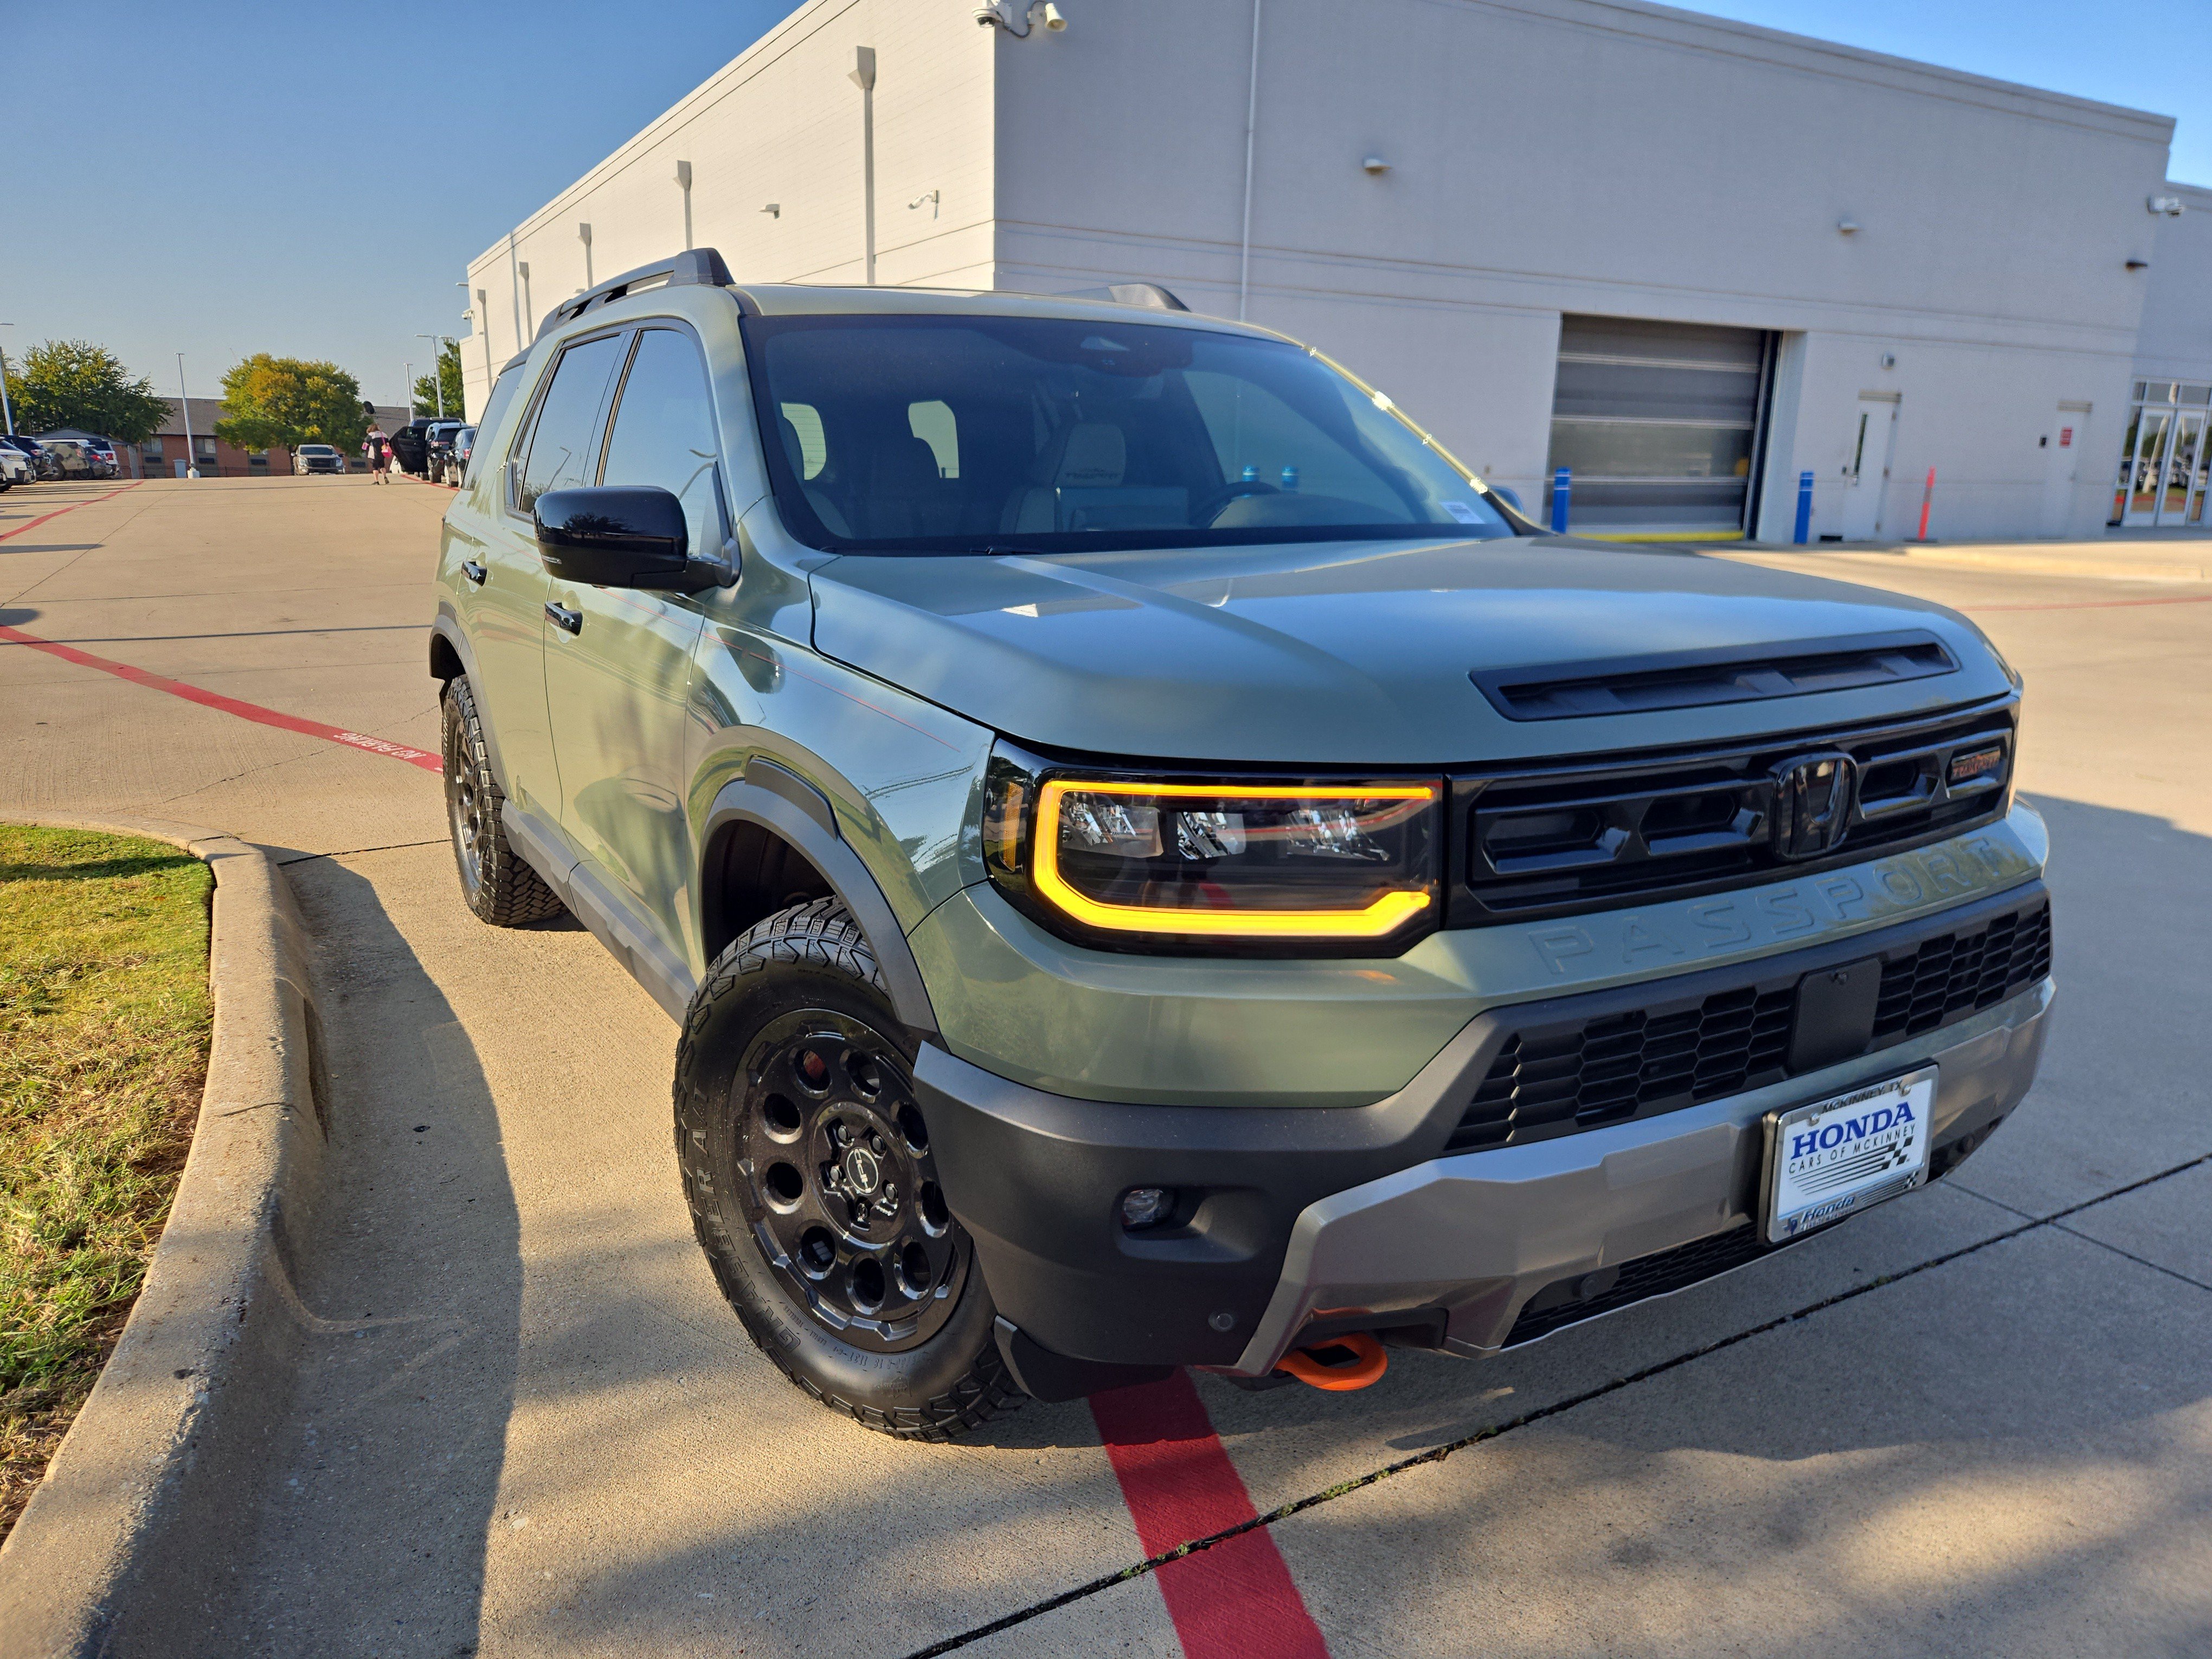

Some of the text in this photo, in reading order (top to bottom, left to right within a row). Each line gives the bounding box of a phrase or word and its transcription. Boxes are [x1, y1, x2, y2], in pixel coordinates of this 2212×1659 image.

[333, 733, 403, 752] PARKING
[1527, 837, 2001, 975] PASSPORT
[1789, 1123, 1916, 1174] CARS OF MCKINNEY
[1790, 1101, 1915, 1160] HONDA
[1800, 1195, 1856, 1224] Honda
